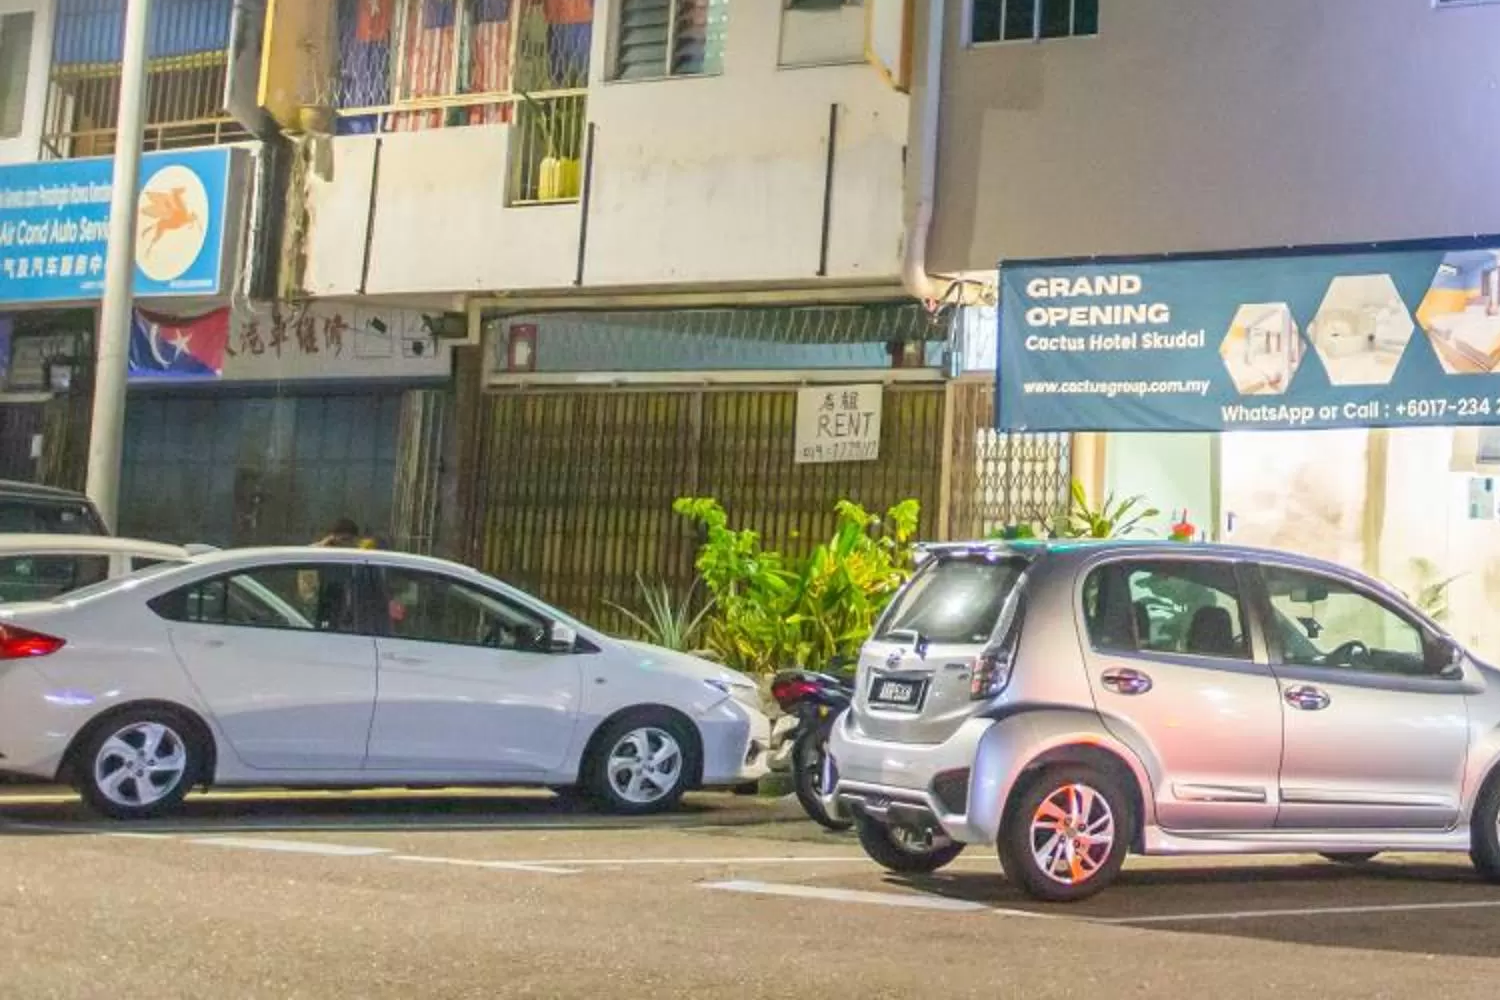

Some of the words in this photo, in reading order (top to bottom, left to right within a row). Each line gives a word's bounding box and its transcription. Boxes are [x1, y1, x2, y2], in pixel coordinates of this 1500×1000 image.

[17, 219, 48, 245] Cond
[49, 217, 77, 243] Auto
[1025, 274, 1142, 299] GRAND
[1025, 303, 1171, 327] OPENING
[1025, 333, 1086, 352] Cactus
[1090, 332, 1137, 351] Hotel
[1141, 329, 1206, 350] Skudai
[1024, 376, 1211, 399] www.cactusgroup.com.my
[1221, 402, 1315, 425] WhatsApp
[1319, 405, 1338, 421] or
[1342, 401, 1380, 421] Call
[1395, 396, 1491, 418] +6017-234
[816, 410, 875, 438] RENT
